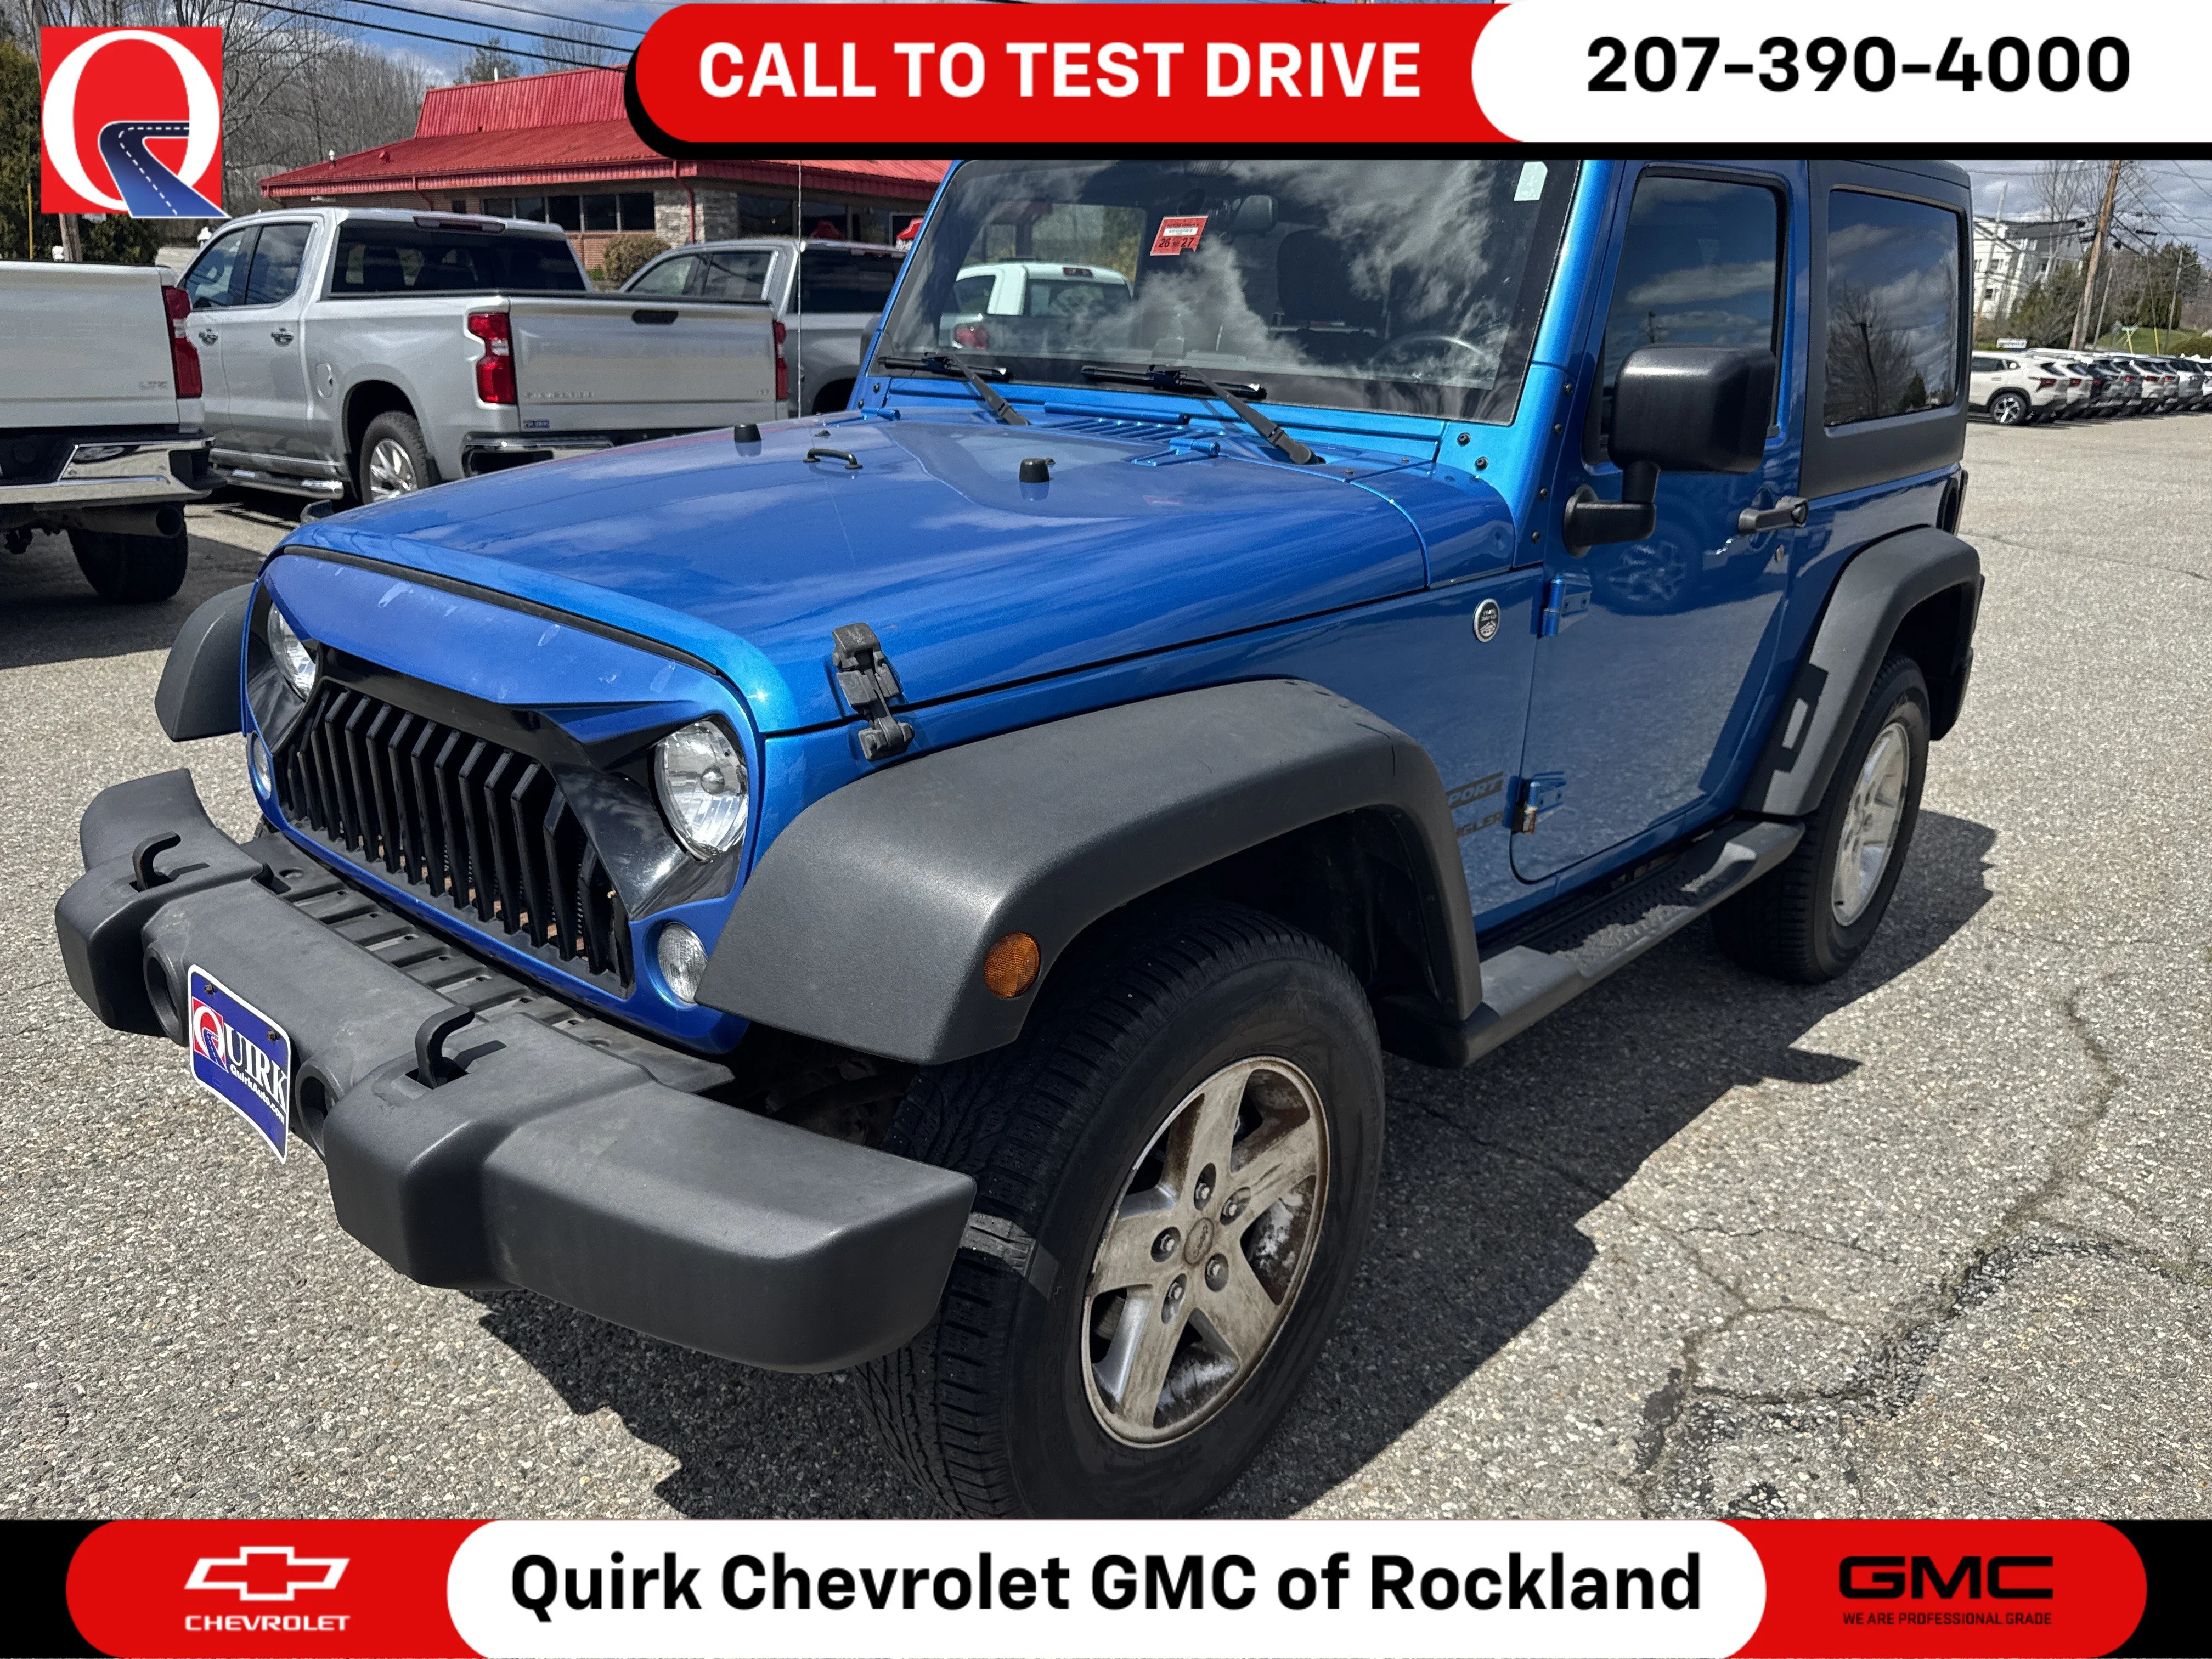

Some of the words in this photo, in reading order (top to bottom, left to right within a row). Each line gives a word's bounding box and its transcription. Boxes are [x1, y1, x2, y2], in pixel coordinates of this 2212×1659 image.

[1159, 238, 1171, 248] 26
[1181, 237, 1195, 247] 27
[1448, 776, 1504, 806] PORT
[1455, 811, 1503, 837] GLER
[193, 1006, 287, 1115] QUIRK
[230, 1063, 285, 1125] QuirkAuto.com
